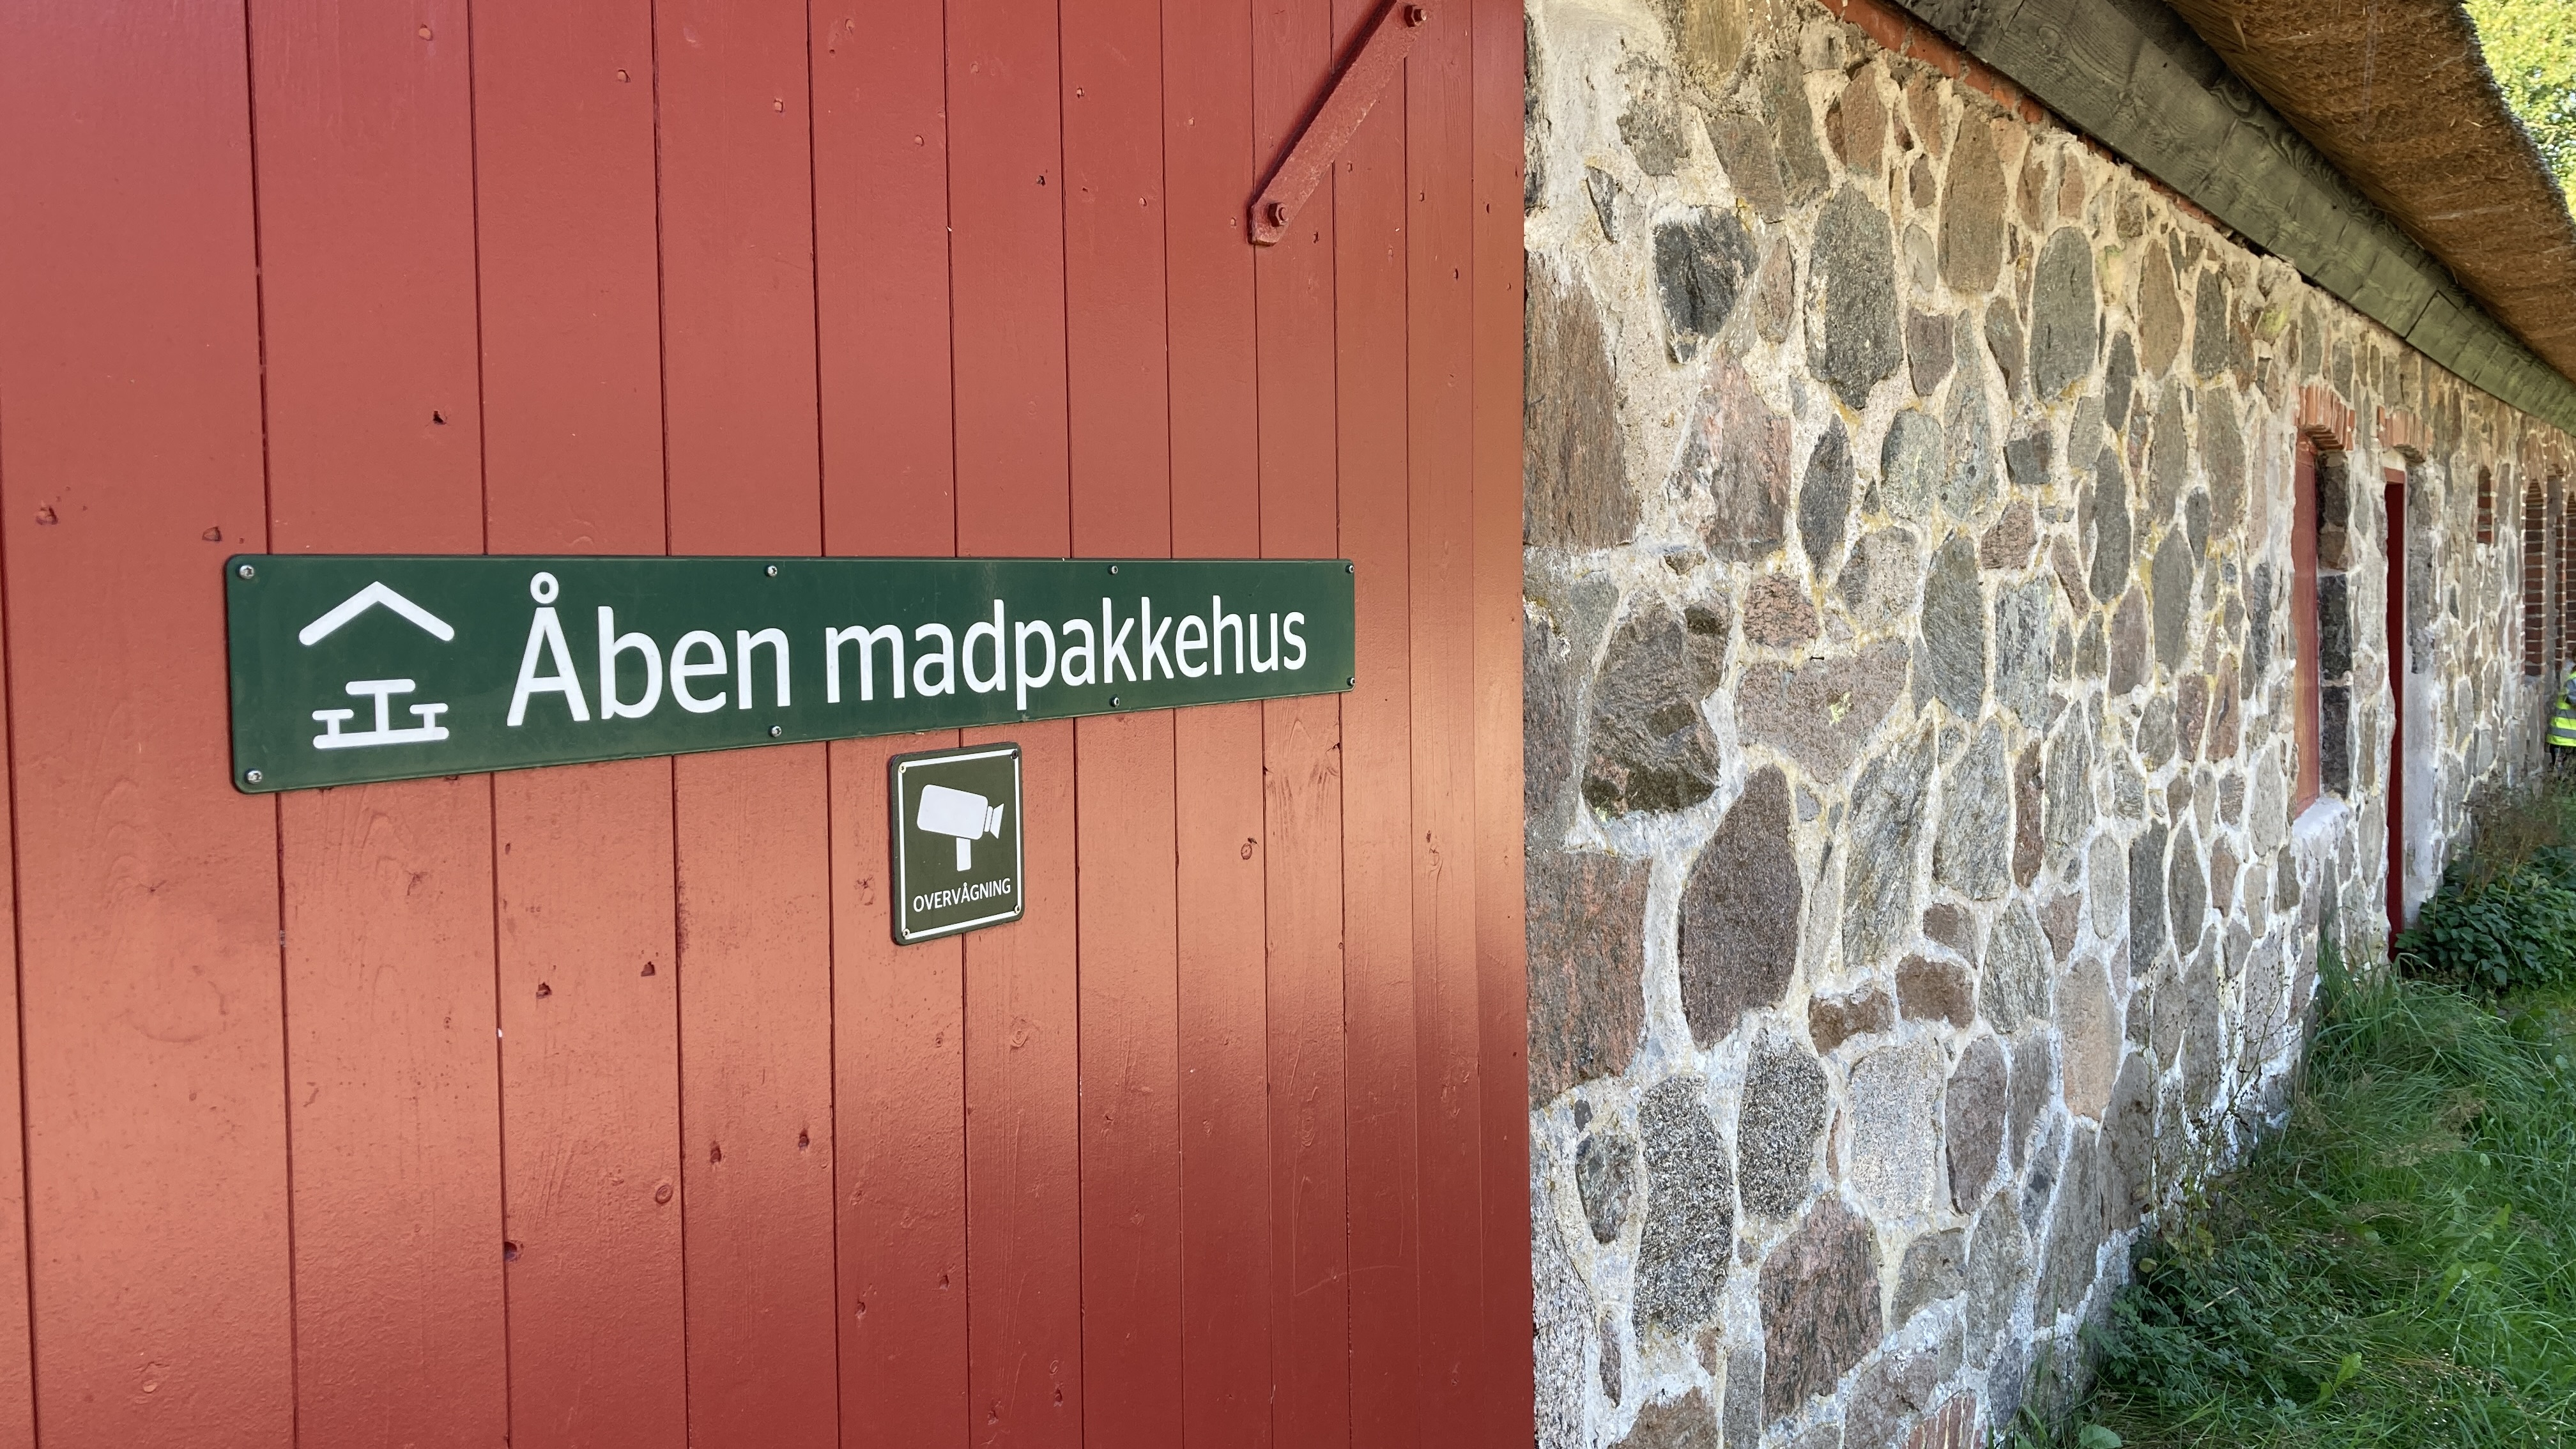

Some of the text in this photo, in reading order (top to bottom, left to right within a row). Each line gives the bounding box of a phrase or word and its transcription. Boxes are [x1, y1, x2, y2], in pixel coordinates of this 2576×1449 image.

[507, 572, 1307, 726] Åben madpakkehus
[913, 878, 1011, 912] OVERVÅGNING
